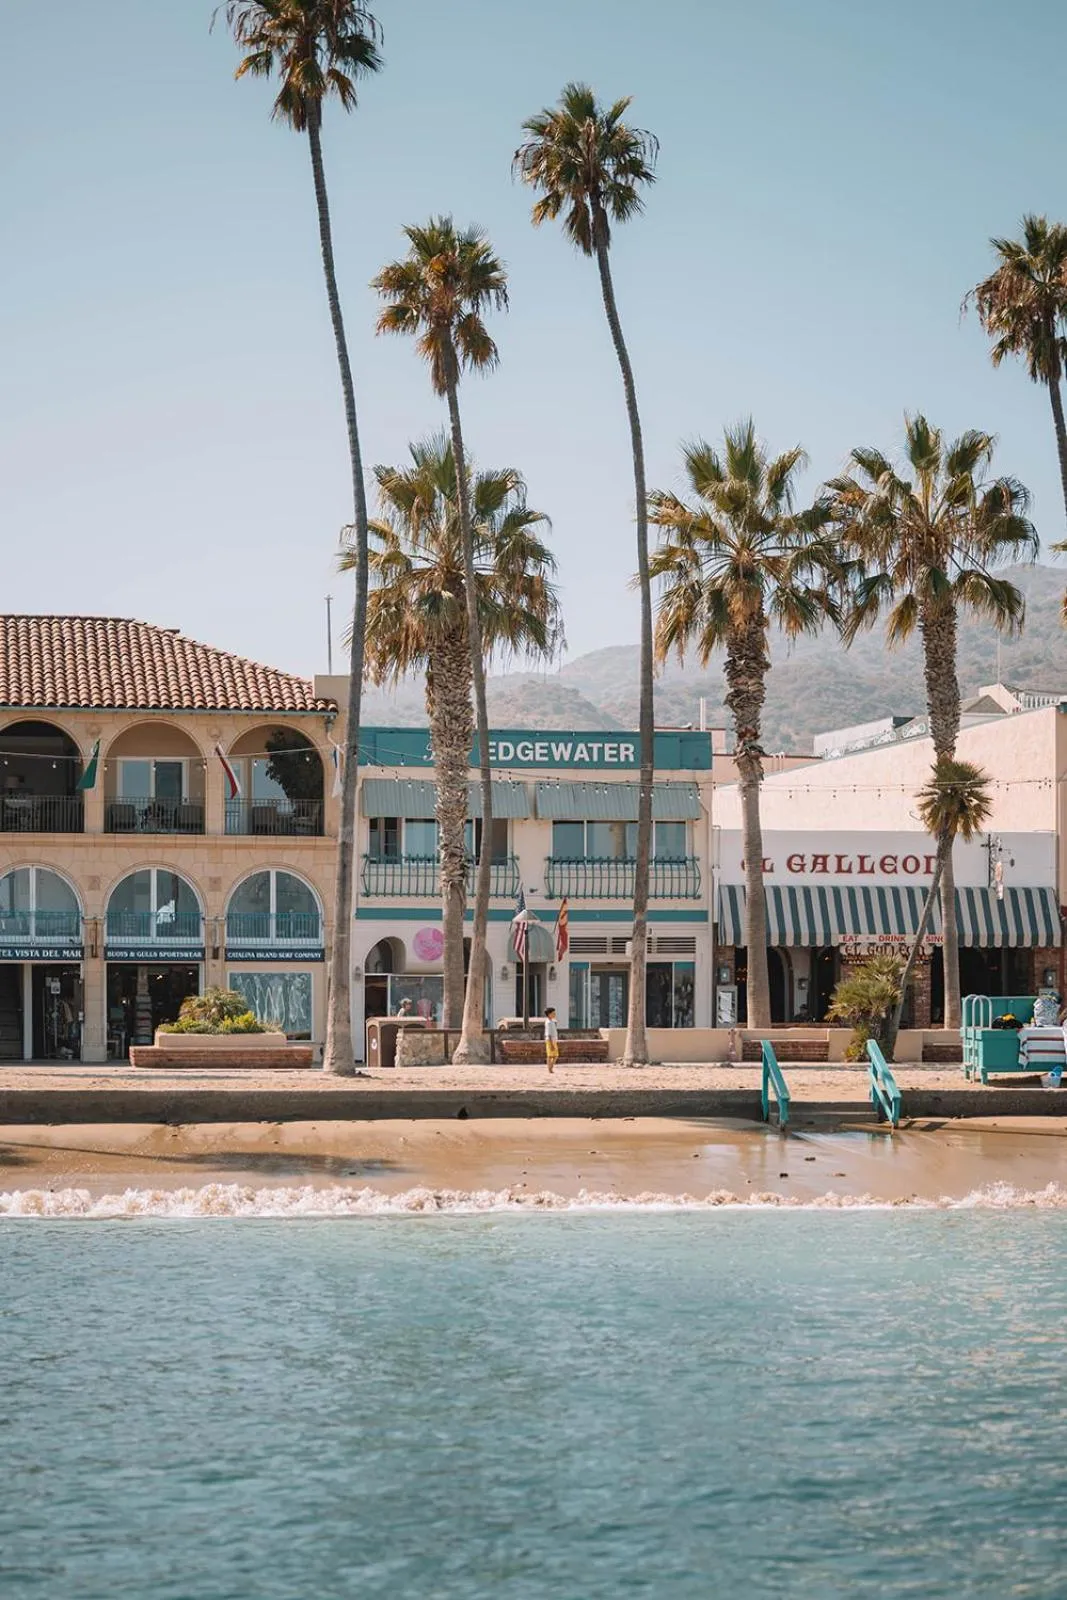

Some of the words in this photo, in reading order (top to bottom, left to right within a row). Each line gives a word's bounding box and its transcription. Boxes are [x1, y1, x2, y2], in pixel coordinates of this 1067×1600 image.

[488, 741, 635, 762] EDGEWATER
[0, 949, 14, 957] EL
[15, 949, 40, 957] VISTA
[42, 949, 60, 957] DEL
[62, 949, 82, 957] MAR
